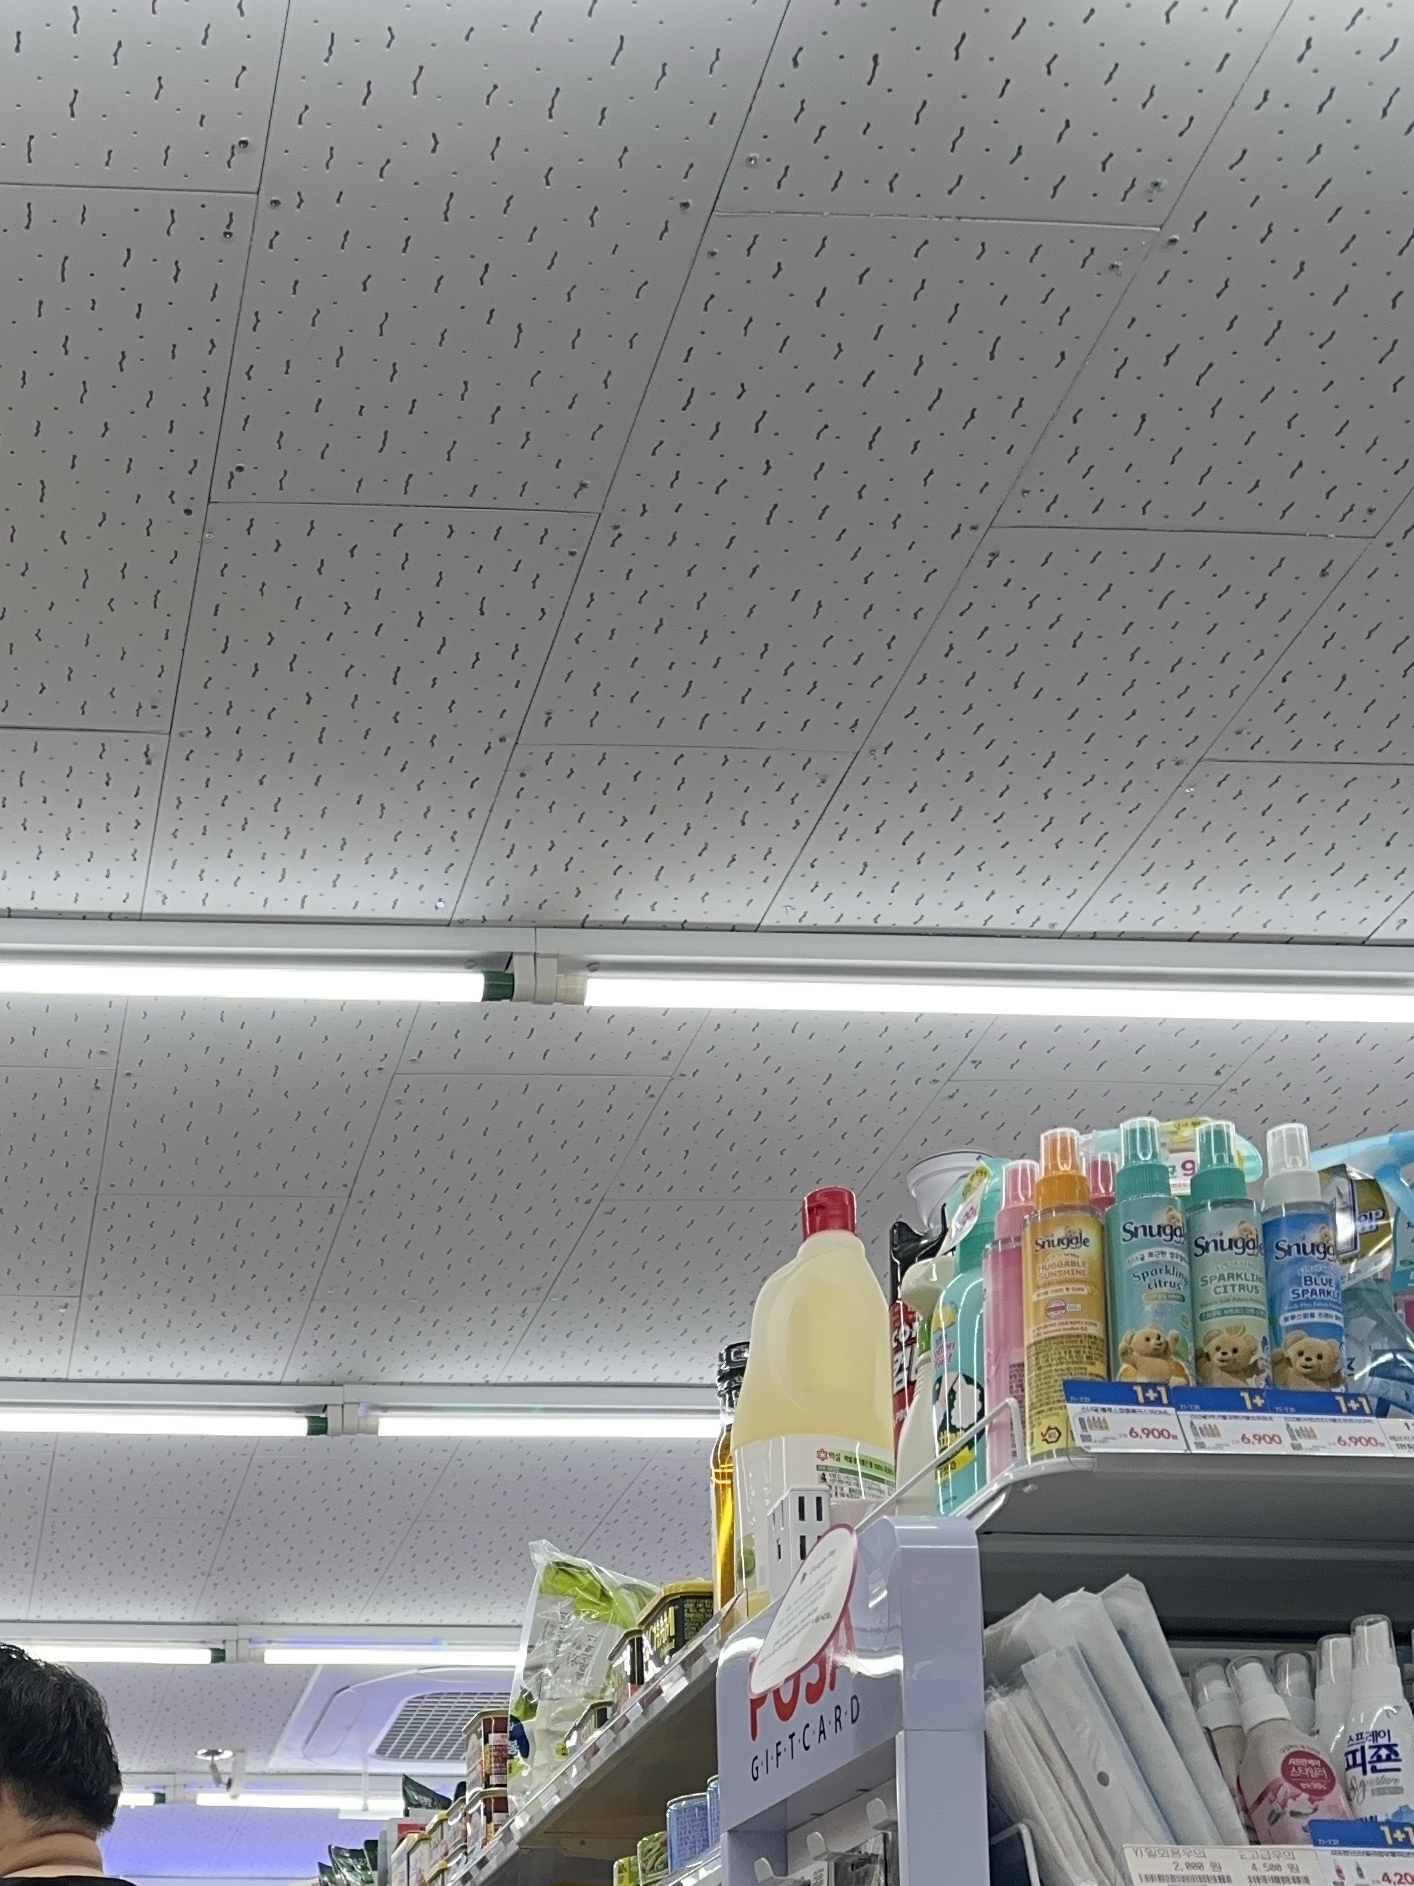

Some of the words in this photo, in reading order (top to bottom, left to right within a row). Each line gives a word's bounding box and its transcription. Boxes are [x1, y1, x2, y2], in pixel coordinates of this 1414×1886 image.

[1034, 1226, 1090, 1253] Snuggle
[1037, 1259, 1087, 1272] HUGGABLE
[1036, 1267, 1088, 1281] SUNSHINE
[1131, 1265, 1189, 1286] Sparkling
[1147, 1277, 1183, 1291] citrus
[1303, 1275, 1335, 1289] BLUE
[1212, 1284, 1261, 1296] CITRUS
[1133, 1384, 1169, 1405] 1+1
[1239, 1390, 1266, 1411] 1+
[1335, 1394, 1372, 1416] 1+1
[1240, 1432, 1284, 1446] 6,900
[1344, 1742, 1404, 1776] 피죤
[1379, 1825, 1414, 1846] 1+1
[1209, 1860, 1223, 1873] 원
[1286, 1861, 1300, 1874] 원
